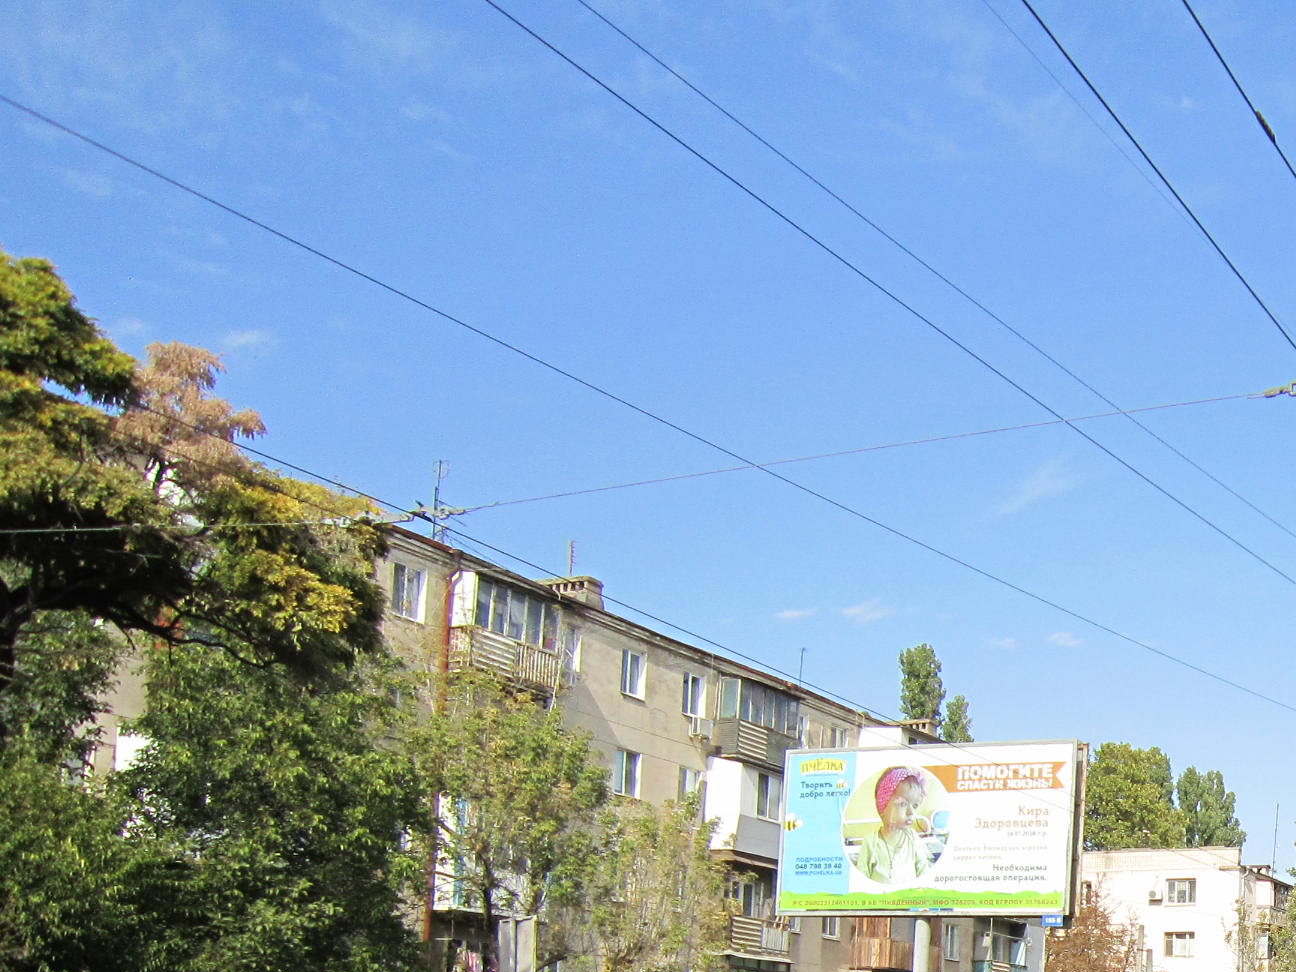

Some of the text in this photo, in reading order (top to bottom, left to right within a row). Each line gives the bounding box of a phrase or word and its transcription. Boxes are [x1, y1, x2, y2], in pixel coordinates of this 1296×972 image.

[801, 757, 844, 773] ПЧЁЛКА
[957, 763, 1054, 780] ПОМОГИТЕ
[800, 781, 833, 790] Творить
[957, 778, 1054, 791] СПАСТИ ЖИЗНЬ!
[800, 788, 851, 799] добро легко!
[1018, 805, 1049, 818] Кира
[974, 817, 1049, 831] Здоровцева
[992, 863, 1048, 872] Необходима
[934, 874, 1000, 884] дорогостоящая
